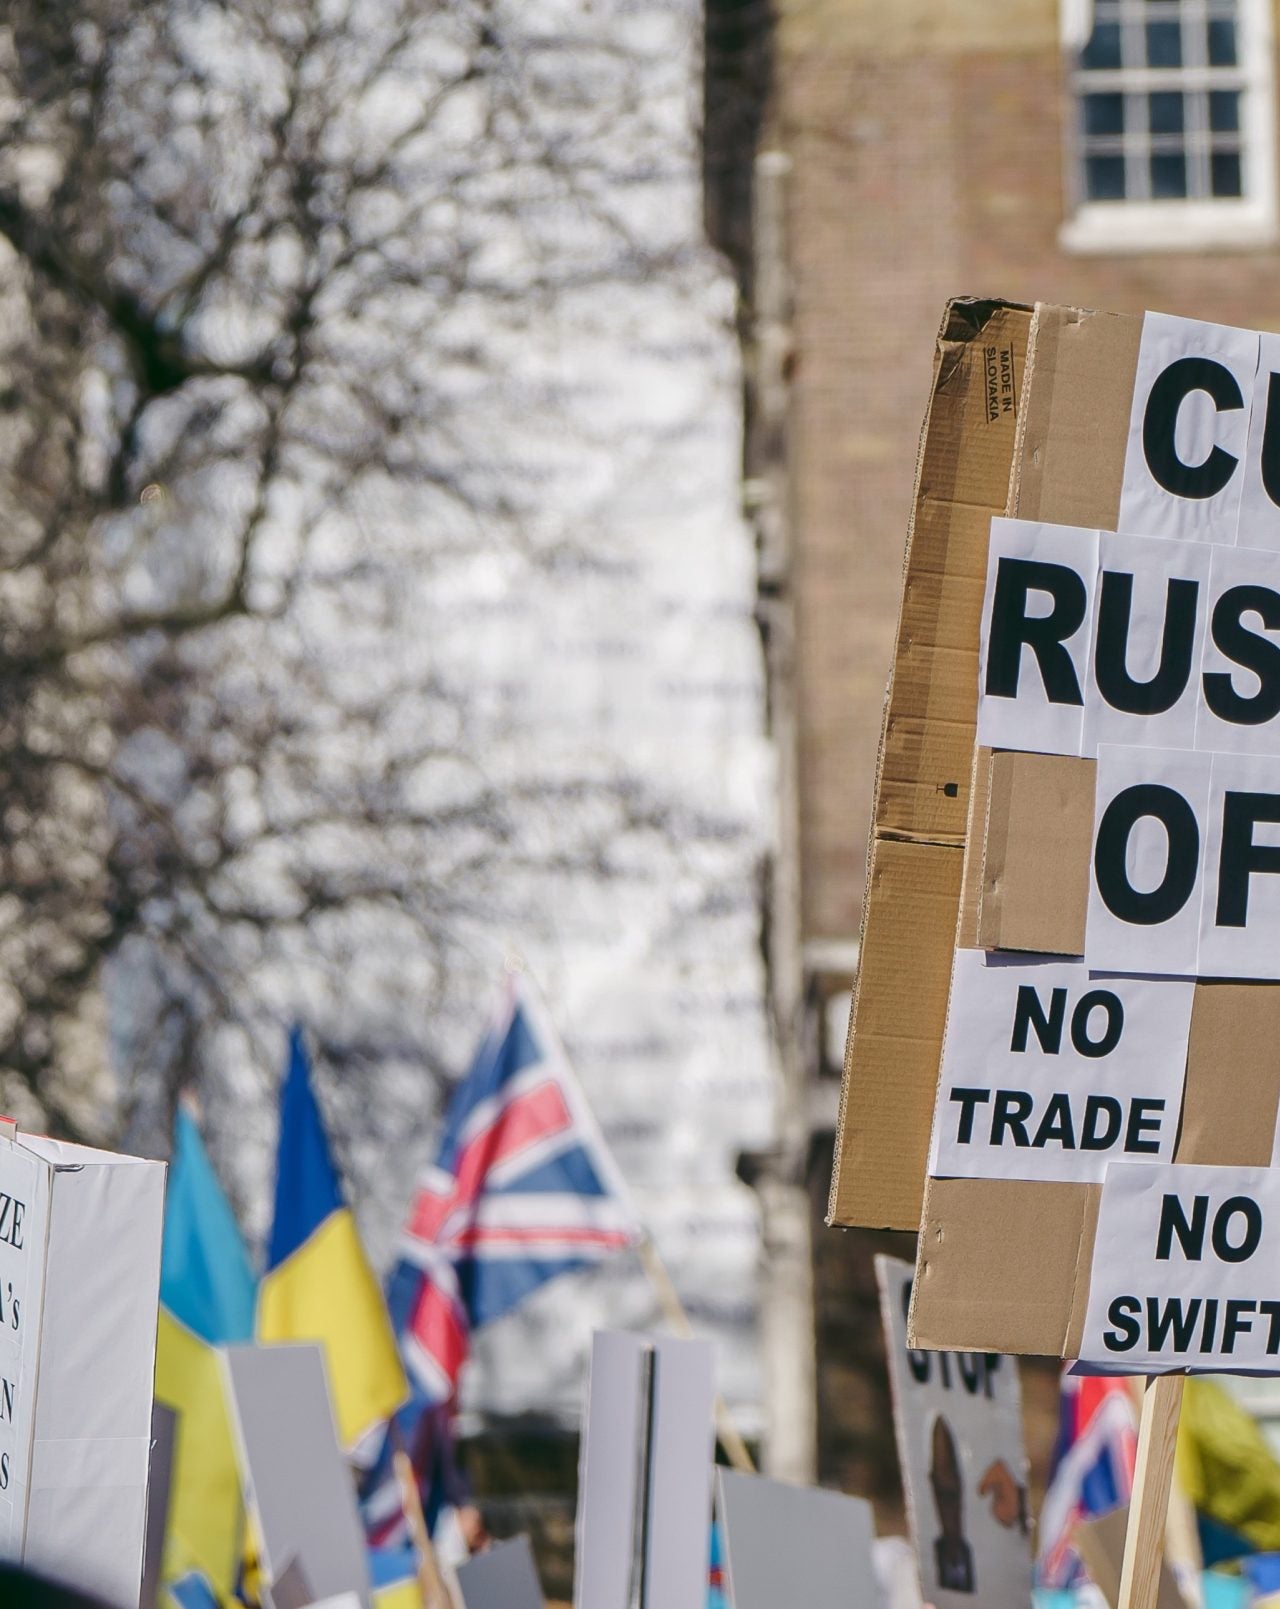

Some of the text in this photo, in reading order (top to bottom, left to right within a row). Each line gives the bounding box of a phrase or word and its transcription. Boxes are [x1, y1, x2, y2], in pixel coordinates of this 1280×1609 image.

[987, 347, 999, 421] SLOVAKIA
[1000, 350, 1012, 412] MADE IN
[1010, 985, 1124, 1058] NO
[949, 1087, 1166, 1154] TRADE
[1155, 1194, 1262, 1263] NO
